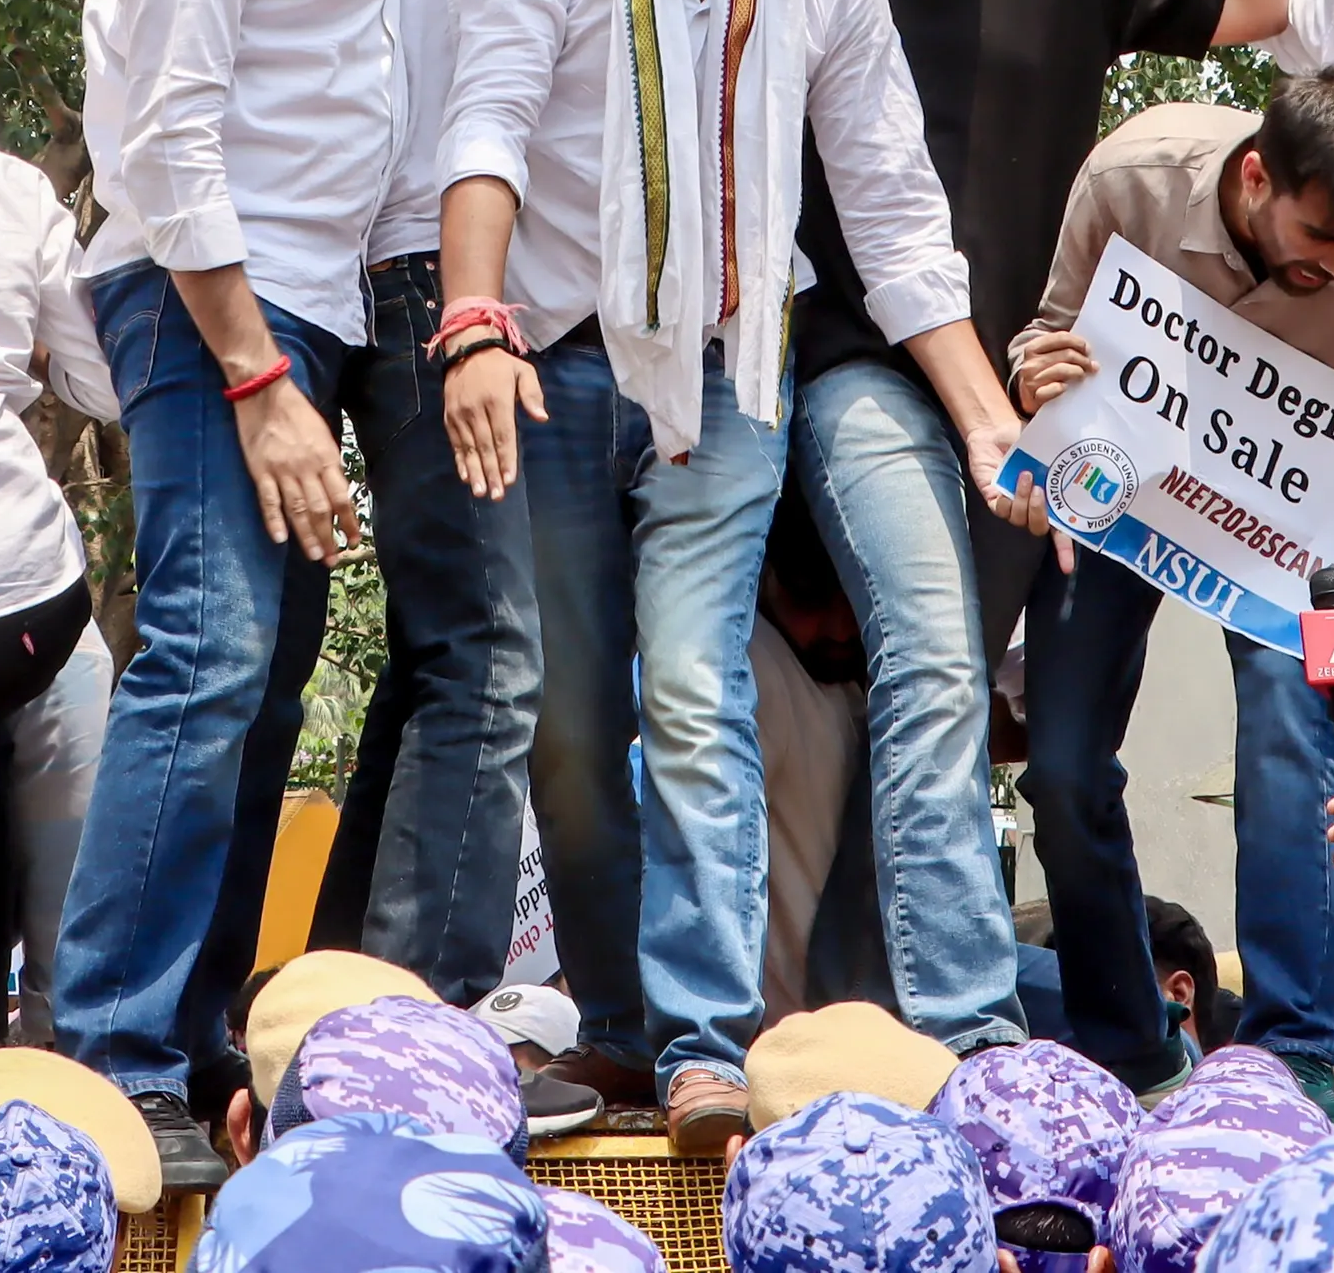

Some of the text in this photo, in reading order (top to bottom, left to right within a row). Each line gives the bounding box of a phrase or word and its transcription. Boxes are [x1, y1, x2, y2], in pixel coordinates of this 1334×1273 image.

[1108, 268, 1241, 378] Doctor
[1119, 355, 1310, 504] On Sale
[1050, 459, 1071, 510] NATIONAL
[1121, 463, 1135, 499] UNION
[1087, 515, 1114, 529] INDIA
[1116, 501, 1127, 514] OF
[1134, 533, 1246, 622] NSUI
[515, 878, 549, 926] addi
[506, 924, 541, 966] chor
